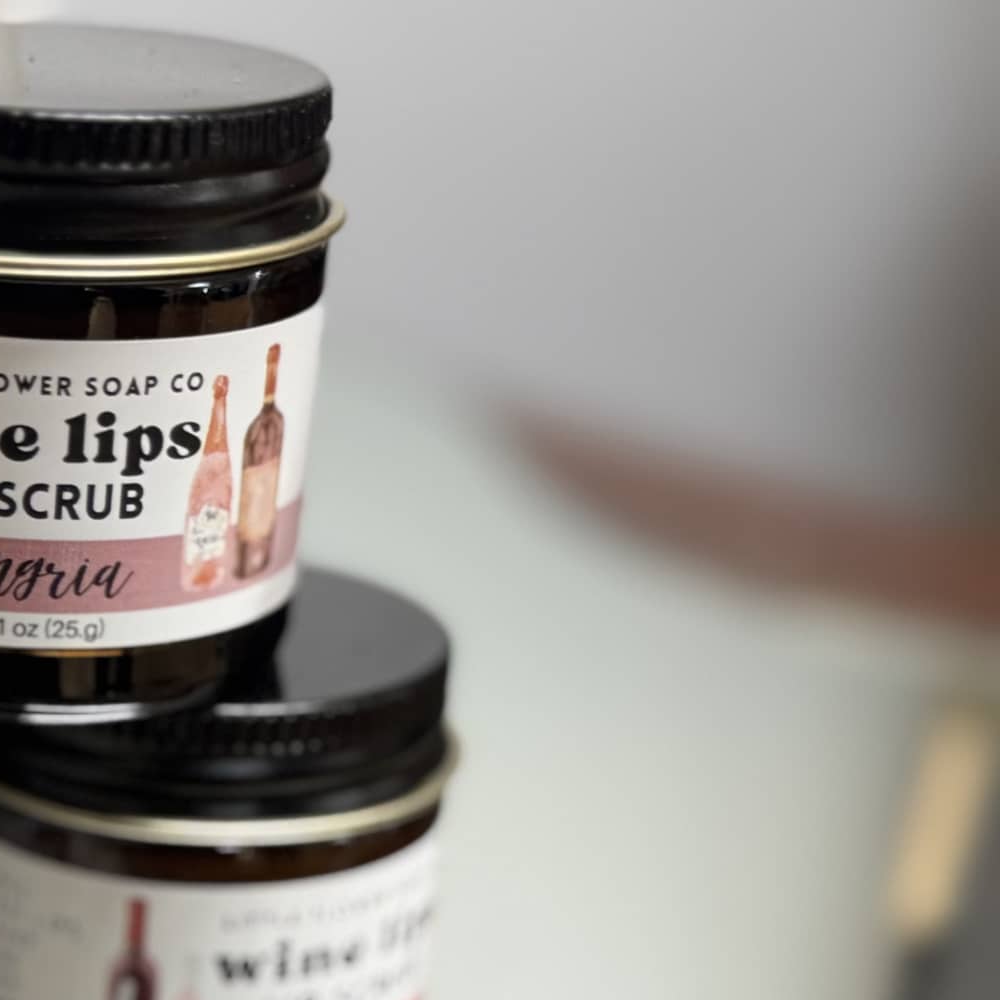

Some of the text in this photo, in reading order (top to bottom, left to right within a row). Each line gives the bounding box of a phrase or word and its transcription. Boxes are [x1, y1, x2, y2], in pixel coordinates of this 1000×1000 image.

[84, 375, 158, 397] SOAP
[171, 372, 204, 393] CO
[62, 411, 202, 477] lips
[12, 622, 39, 639] oz
